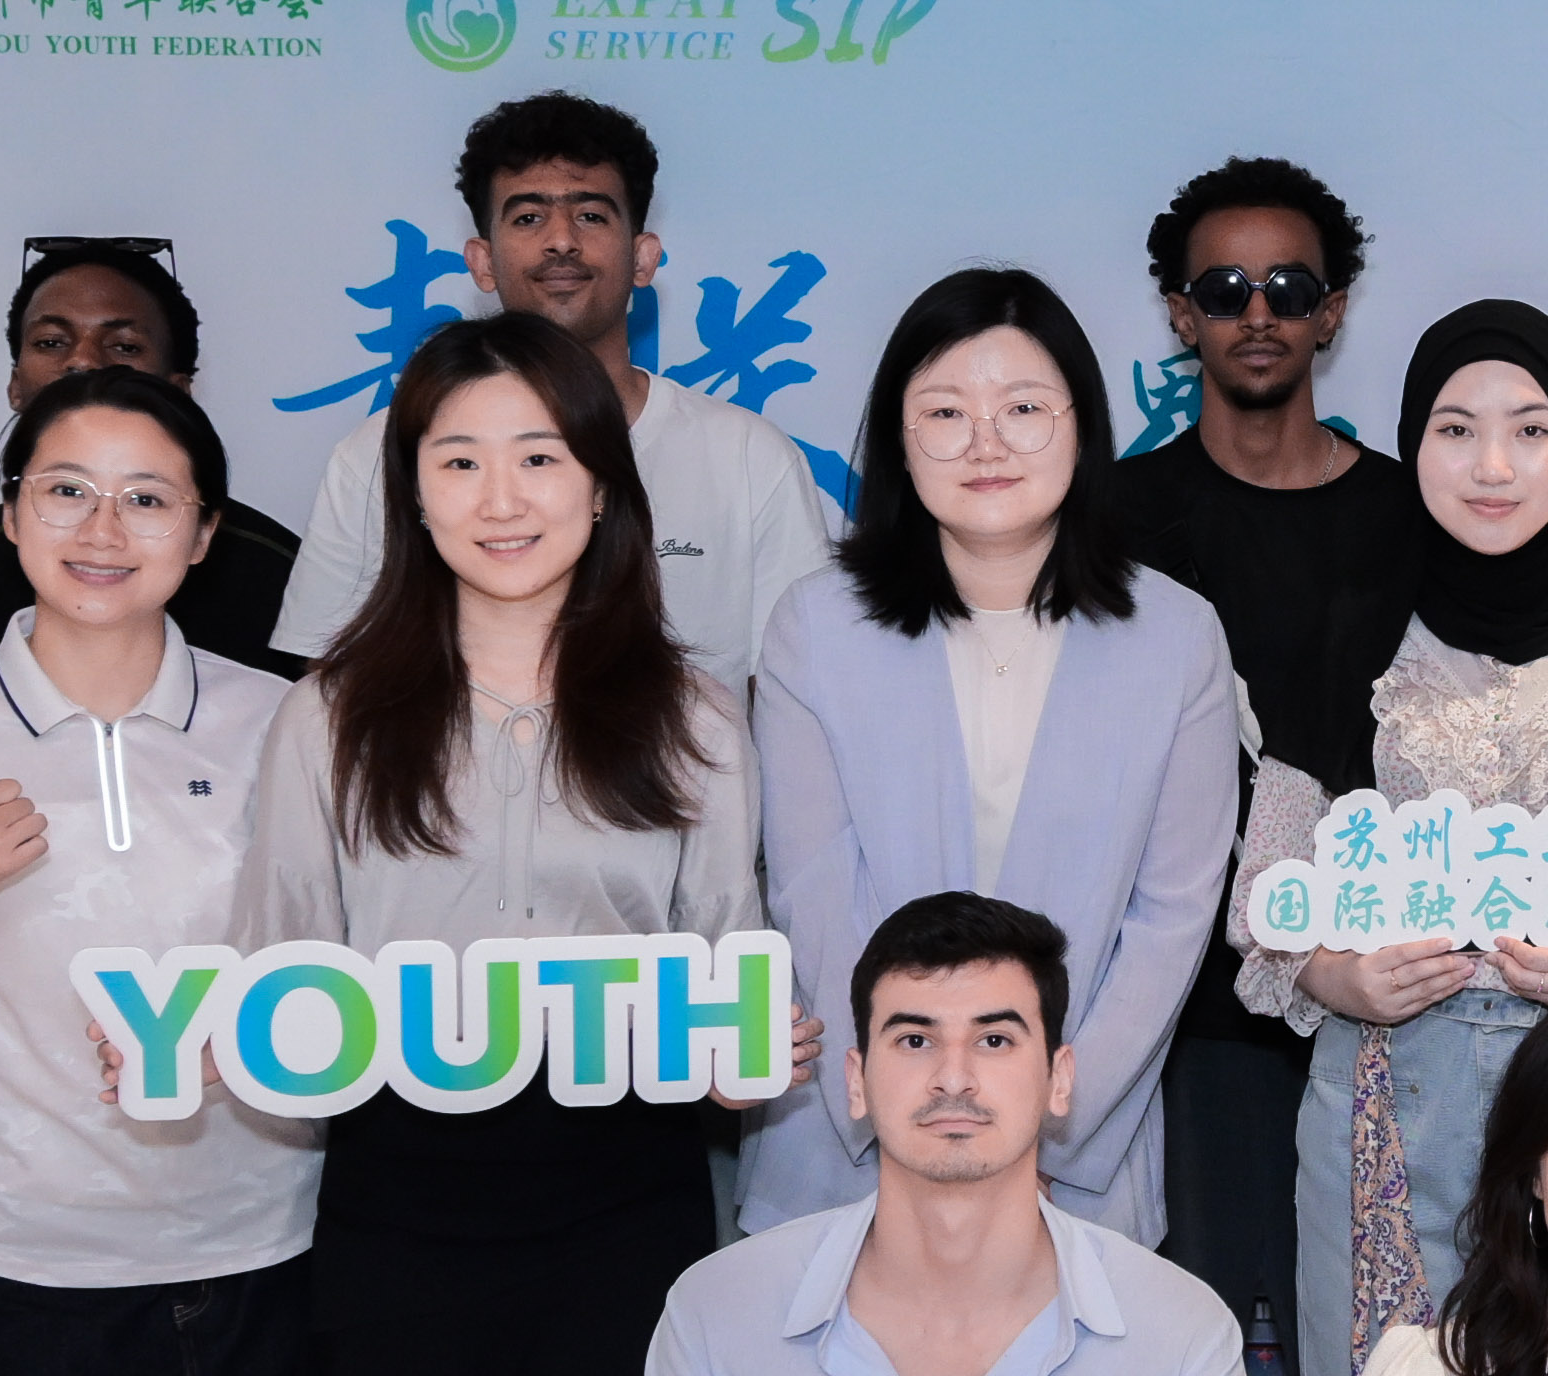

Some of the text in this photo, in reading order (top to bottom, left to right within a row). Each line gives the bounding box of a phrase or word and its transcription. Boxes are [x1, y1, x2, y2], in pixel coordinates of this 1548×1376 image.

[46, 35, 137, 56] YOUTH
[152, 36, 323, 58] FEDERATION
[544, 29, 735, 61] SERVICE
[94, 954, 771, 1098] YOUTH
